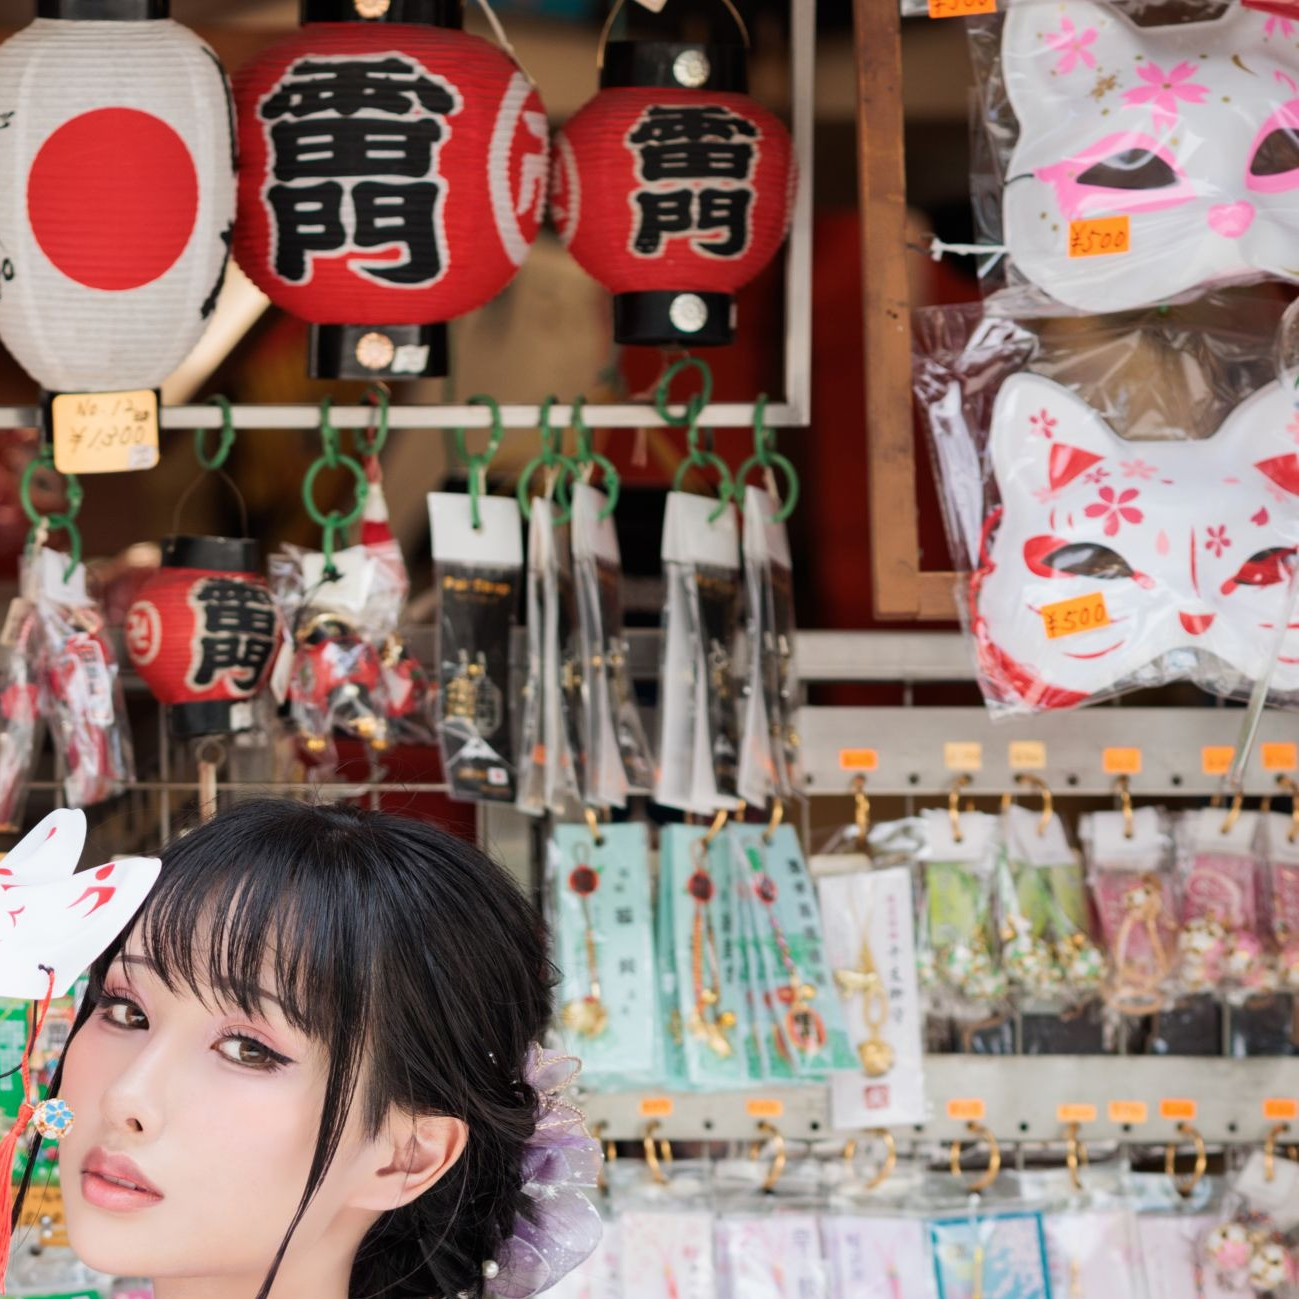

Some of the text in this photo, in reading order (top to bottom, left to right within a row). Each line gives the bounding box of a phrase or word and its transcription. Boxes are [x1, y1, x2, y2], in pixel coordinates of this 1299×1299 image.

[260, 54, 458, 286] 雷門
[626, 105, 759, 258] 雷門
[1070, 224, 1127, 255] ¥500
[194, 578, 276, 691] 雷門
[1044, 601, 1106, 631] ¥500
